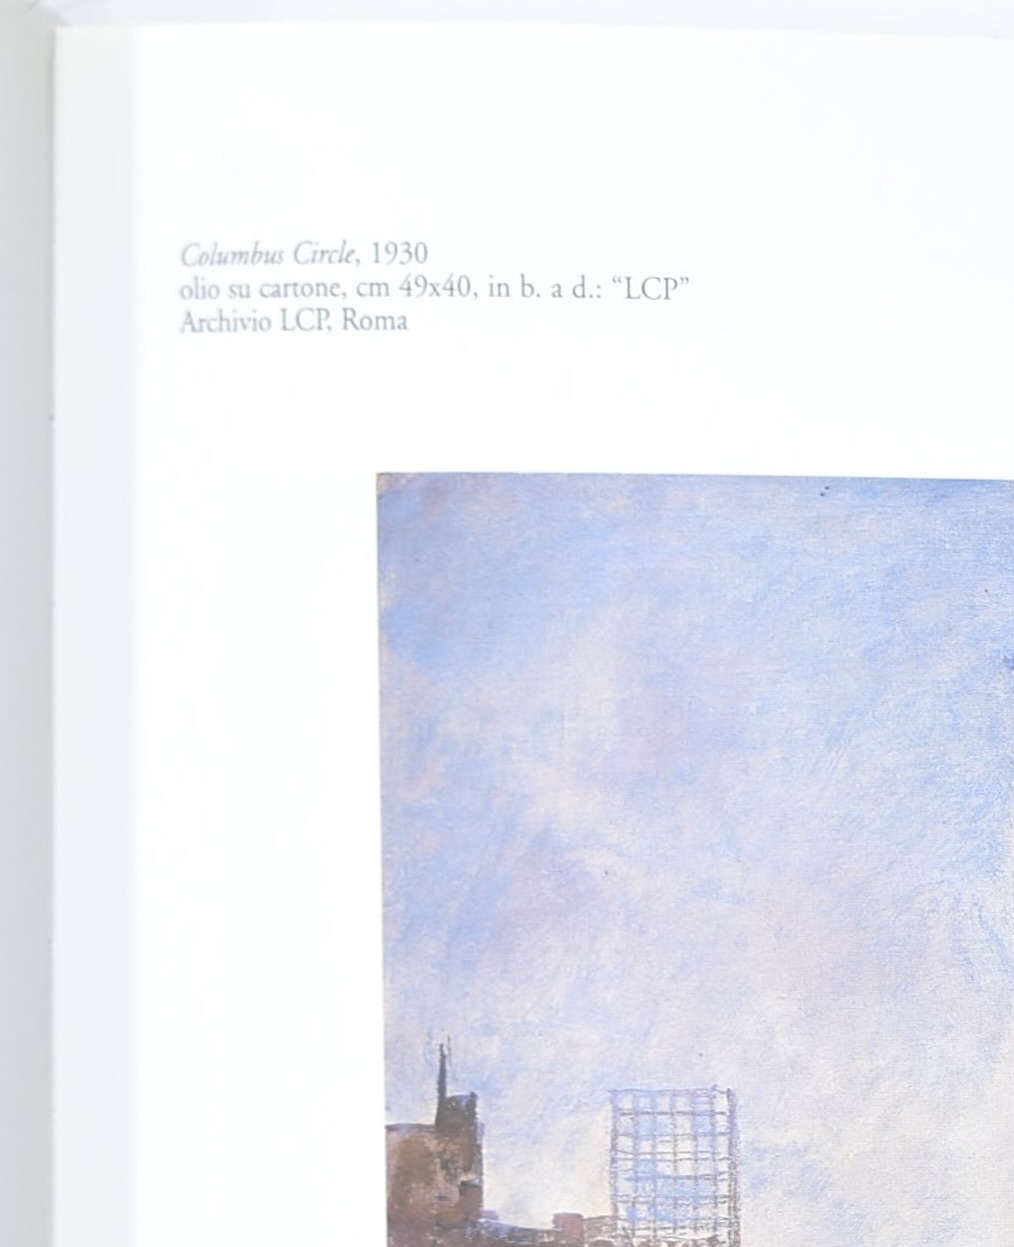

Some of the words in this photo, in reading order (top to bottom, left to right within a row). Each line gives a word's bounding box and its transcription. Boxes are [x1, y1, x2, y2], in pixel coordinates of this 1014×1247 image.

[180, 240, 285, 267] Columbus
[293, 239, 380, 267] Circle,
[384, 241, 429, 266] 1930
[179, 275, 221, 300] olio
[228, 284, 251, 299] su
[258, 280, 348, 300] cartone,
[355, 281, 390, 298] cm
[398, 273, 479, 300] 49x40,
[488, 275, 511, 298] in
[520, 274, 541, 299] b.
[551, 283, 563, 299] a
[571, 274, 602, 299] d.:
[611, 275, 690, 301] “LCP”
[180, 308, 272, 334] Archivio
[280, 306, 333, 333] LCP,
[341, 306, 409, 331] Roma
